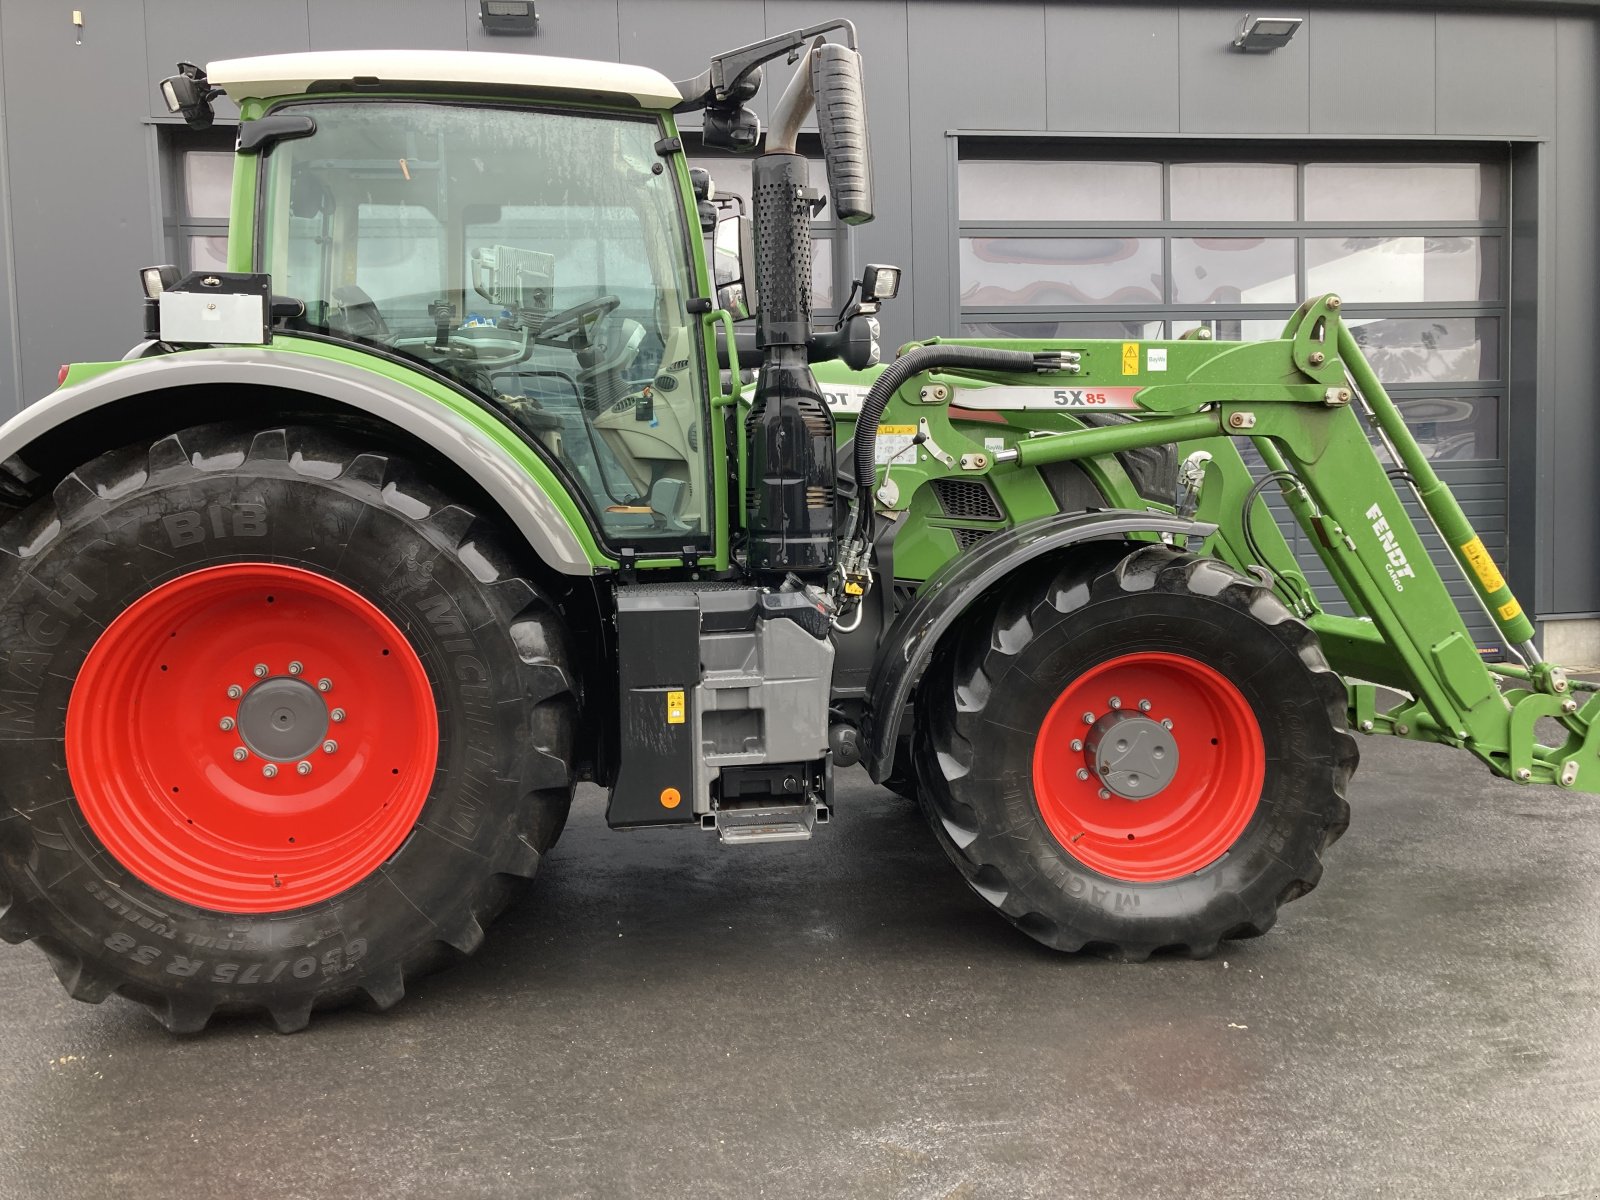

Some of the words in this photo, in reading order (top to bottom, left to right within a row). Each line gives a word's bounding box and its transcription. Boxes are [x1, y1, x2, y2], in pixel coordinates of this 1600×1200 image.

[161, 502, 269, 549] BIB
[1365, 502, 1416, 578] FENDT
[1385, 563, 1404, 592] CARGO
[415, 594, 495, 836] MICHELIN
[211, 937, 369, 984] 650/75
